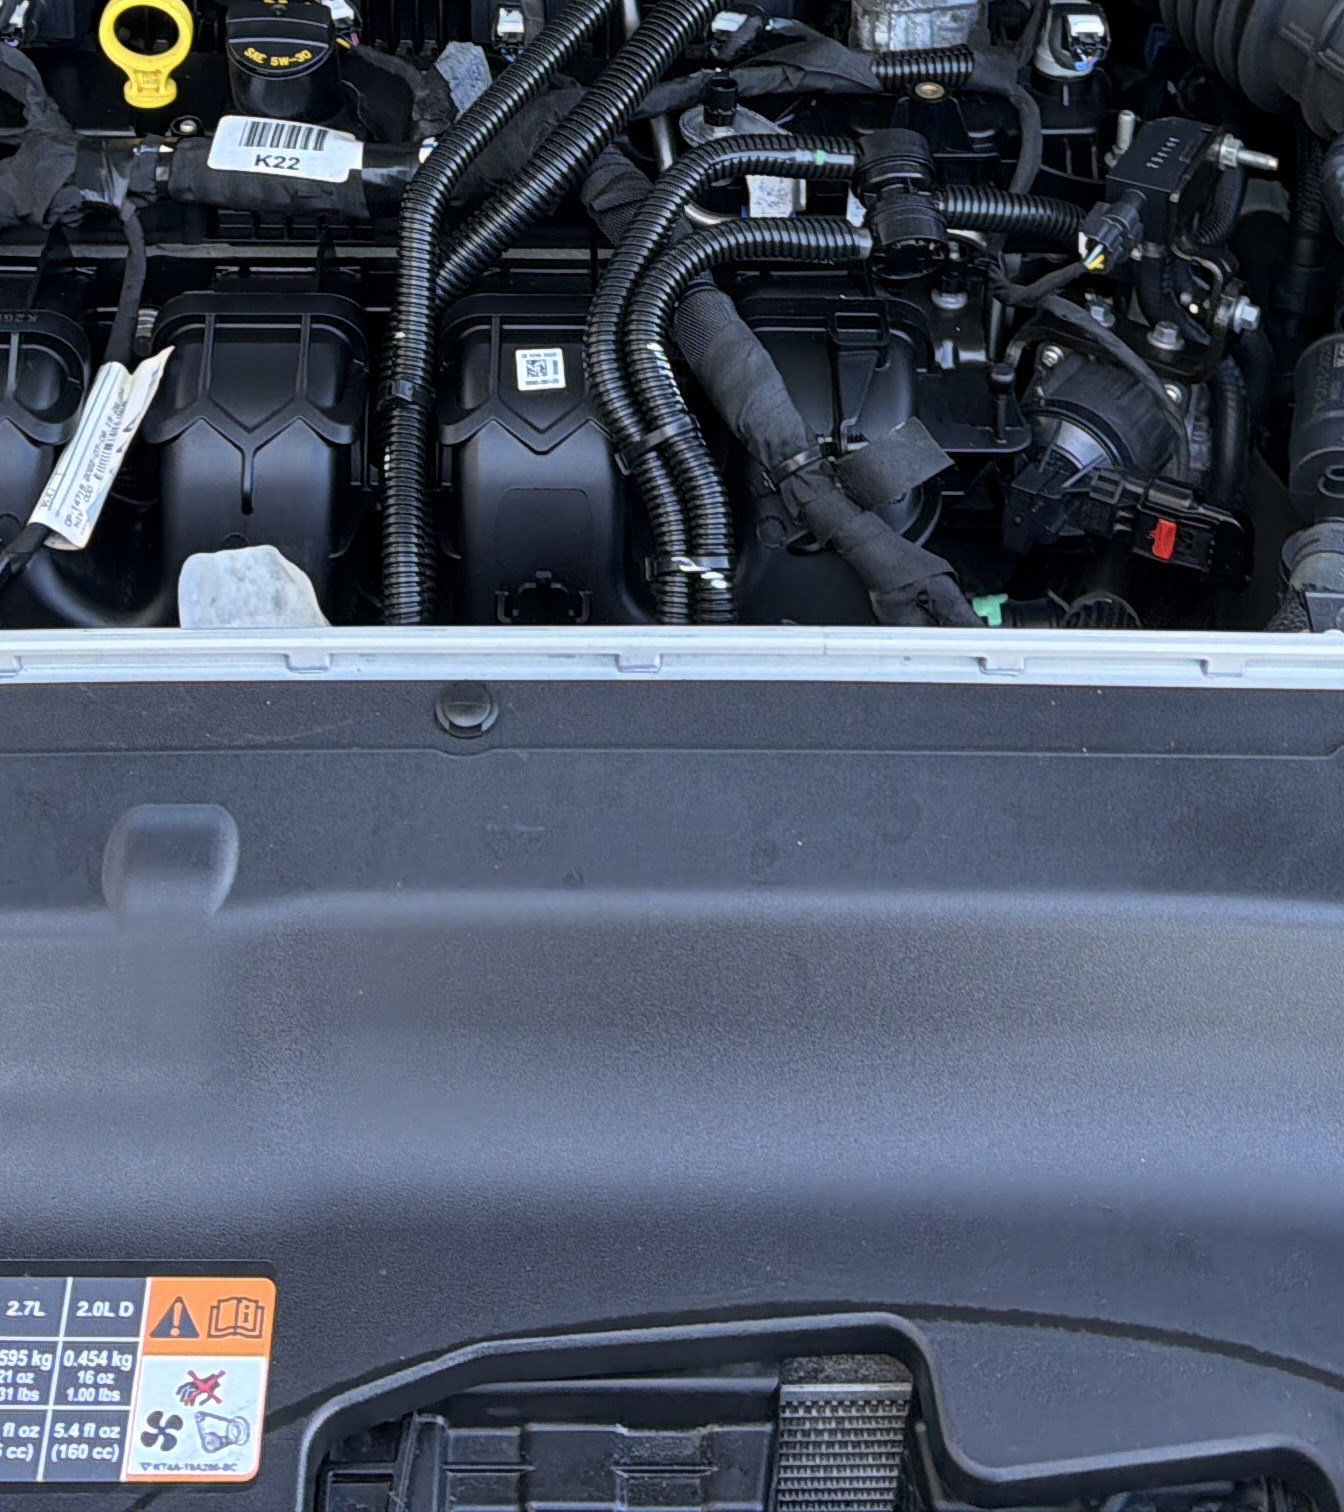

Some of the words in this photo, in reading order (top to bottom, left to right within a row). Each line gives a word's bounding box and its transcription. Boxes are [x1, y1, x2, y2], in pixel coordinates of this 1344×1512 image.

[243, 47, 268, 64] SAE
[269, 49, 313, 67] 5W-30
[254, 153, 302, 172] K22
[4, 1300, 47, 1317] 2.7L
[75, 1300, 115, 1317] 2.0L
[118, 1301, 135, 1317] D
[30, 1349, 54, 1372] kg
[62, 1349, 109, 1368] 0.454
[110, 1349, 134, 1372] kg
[15, 1371, 35, 1385] oz
[76, 1370, 95, 1385] 16
[95, 1372, 116, 1386] oz
[16, 1387, 40, 1403] lbs
[66, 1387, 95, 1403] 1.00
[98, 1387, 122, 1403] lbs
[2, 1422, 16, 1439] fl
[17, 1425, 41, 1439] oz
[52, 1422, 80, 1439] 5.4
[82, 1422, 97, 1439] fl
[98, 1425, 122, 1439] oz
[5, 1443, 35, 1462] cc)
[50, 1443, 89, 1463] (160
[92, 1443, 120, 1463] cc)
